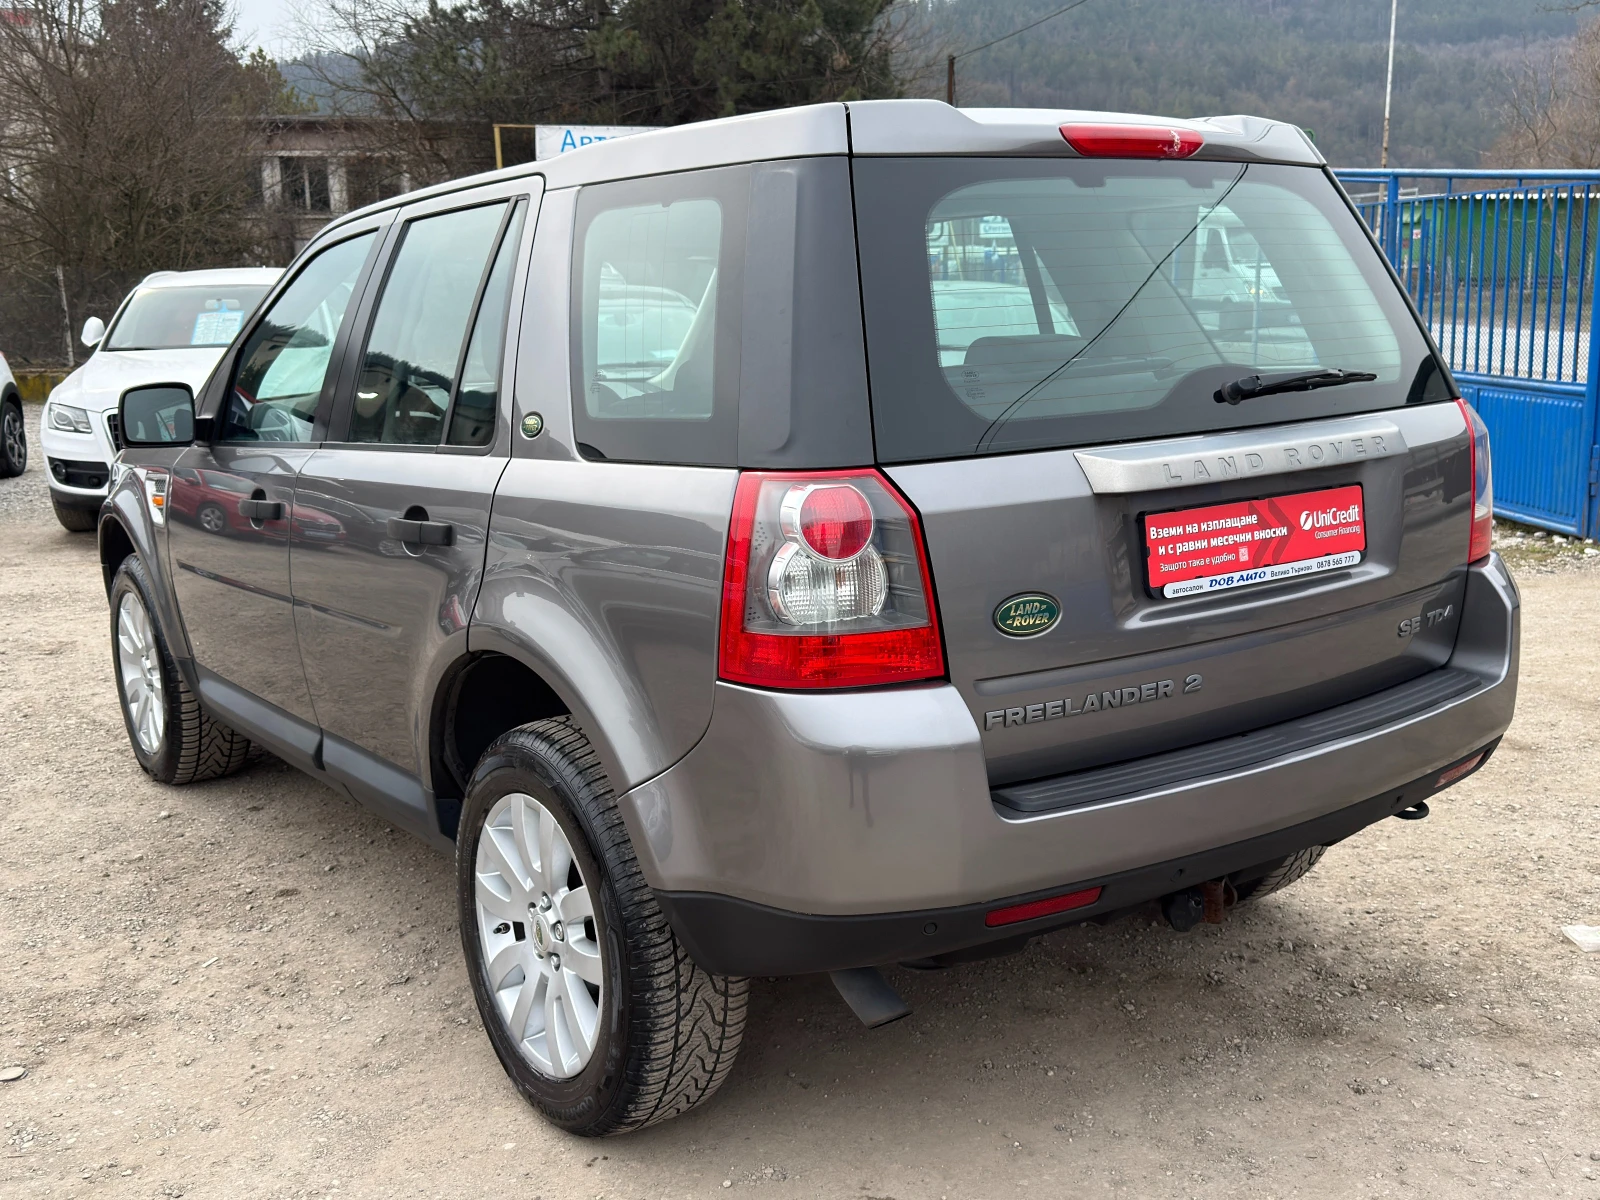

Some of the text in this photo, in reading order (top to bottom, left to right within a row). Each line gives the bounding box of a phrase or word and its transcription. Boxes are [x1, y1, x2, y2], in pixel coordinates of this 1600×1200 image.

[1162, 435, 1388, 483] LAND ROVER
[1150, 514, 1258, 539] Вземи на изплащане
[1313, 504, 1360, 528] UniCredit
[1158, 526, 1288, 556] и с равни месечни вноски
[1314, 525, 1361, 539] Consumer Financing
[1160, 553, 1236, 573] Защото така е удобно
[1172, 583, 1204, 595] автосалон
[1208, 575, 1235, 588] DOB
[1236, 571, 1267, 584] AUTO
[1316, 560, 1331, 569] 0878
[1344, 555, 1355, 565] 777
[1010, 602, 1040, 616] LAND
[1012, 612, 1050, 627] ROVER
[1397, 616, 1421, 638] SE
[985, 673, 1204, 732] FREELANDER 2
